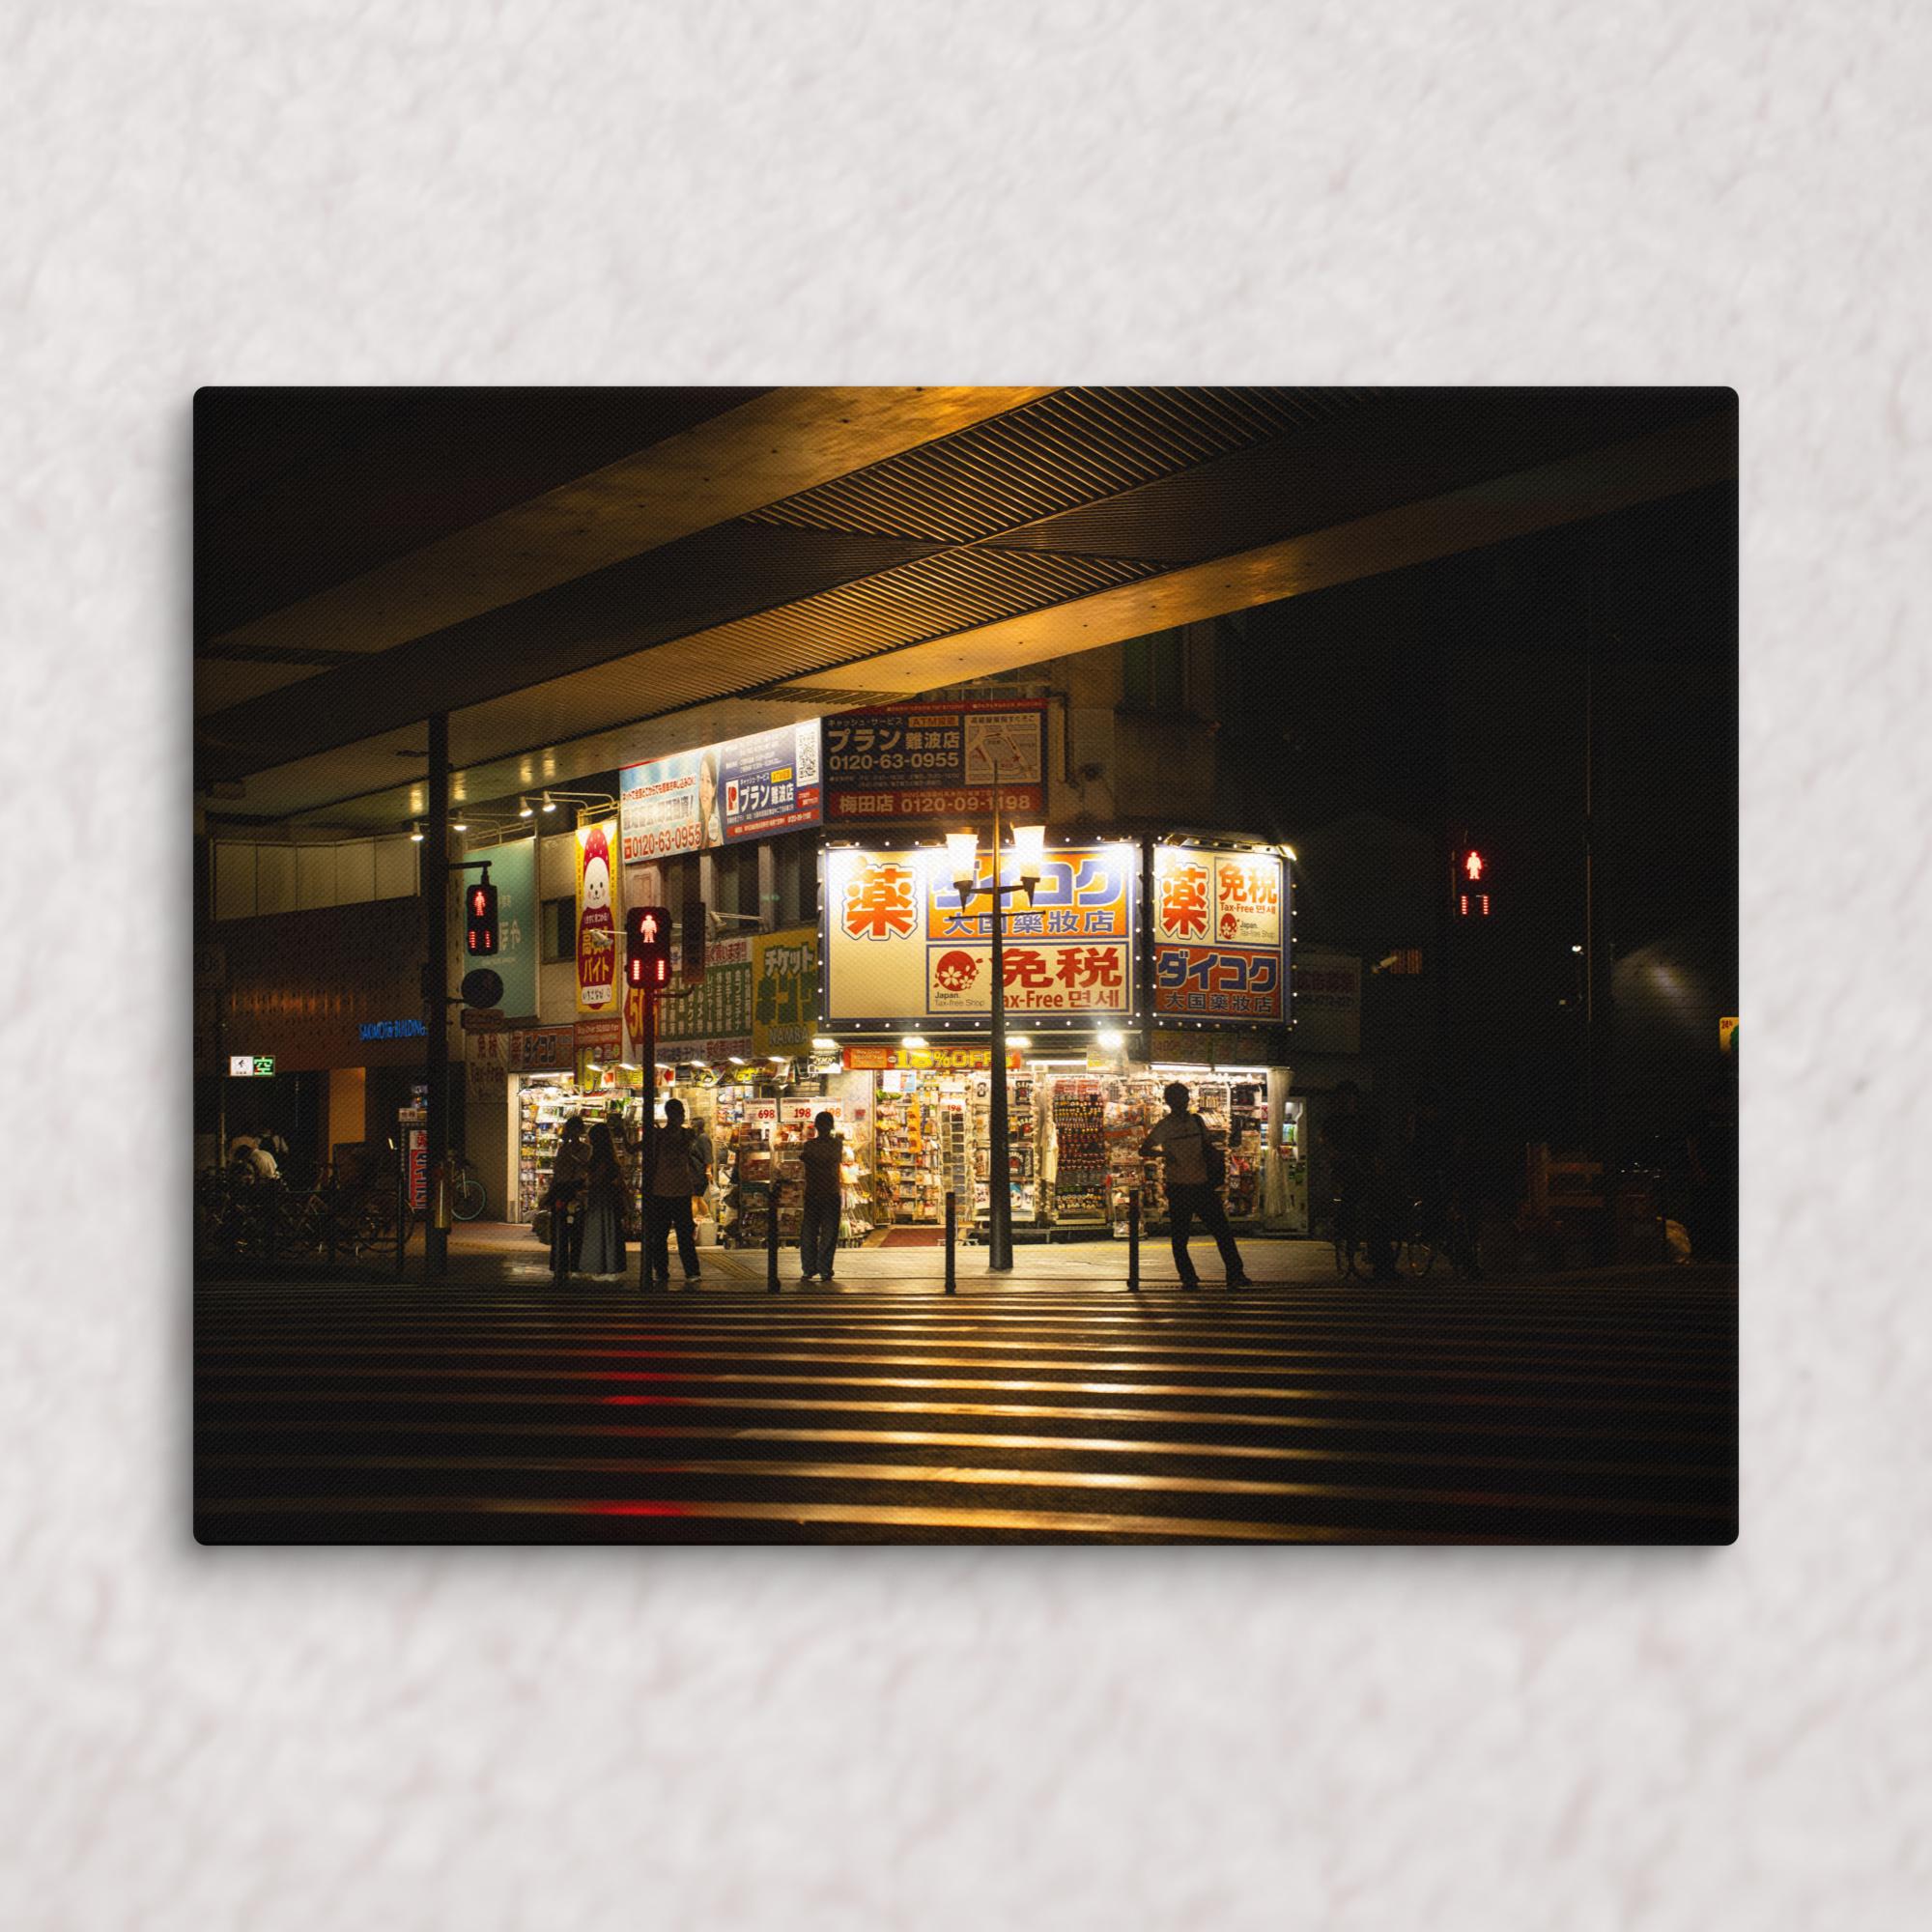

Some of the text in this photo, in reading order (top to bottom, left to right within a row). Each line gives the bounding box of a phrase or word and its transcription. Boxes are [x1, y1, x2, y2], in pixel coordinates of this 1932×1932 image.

[828, 727, 960, 753] プラン 難波店
[830, 752, 959, 771] 0120-63-0955
[739, 784, 770, 812] プラン
[839, 795, 894, 812] 梅田店
[901, 795, 1031, 812] 0120-09-1198
[633, 823, 702, 858] 0120-63-0955
[847, 856, 914, 937] 薬
[1219, 865, 1278, 904] 免税
[1162, 867, 1208, 936] 薬
[1220, 902, 1254, 914] Tax-Free
[765, 945, 814, 977] チケット
[1157, 950, 1278, 995] ダイコク
[991, 990, 1064, 1009] ax-Free
[254, 1056, 273, 1076] 空
[758, 1109, 775, 1119] 698
[793, 1108, 811, 1118] 198
